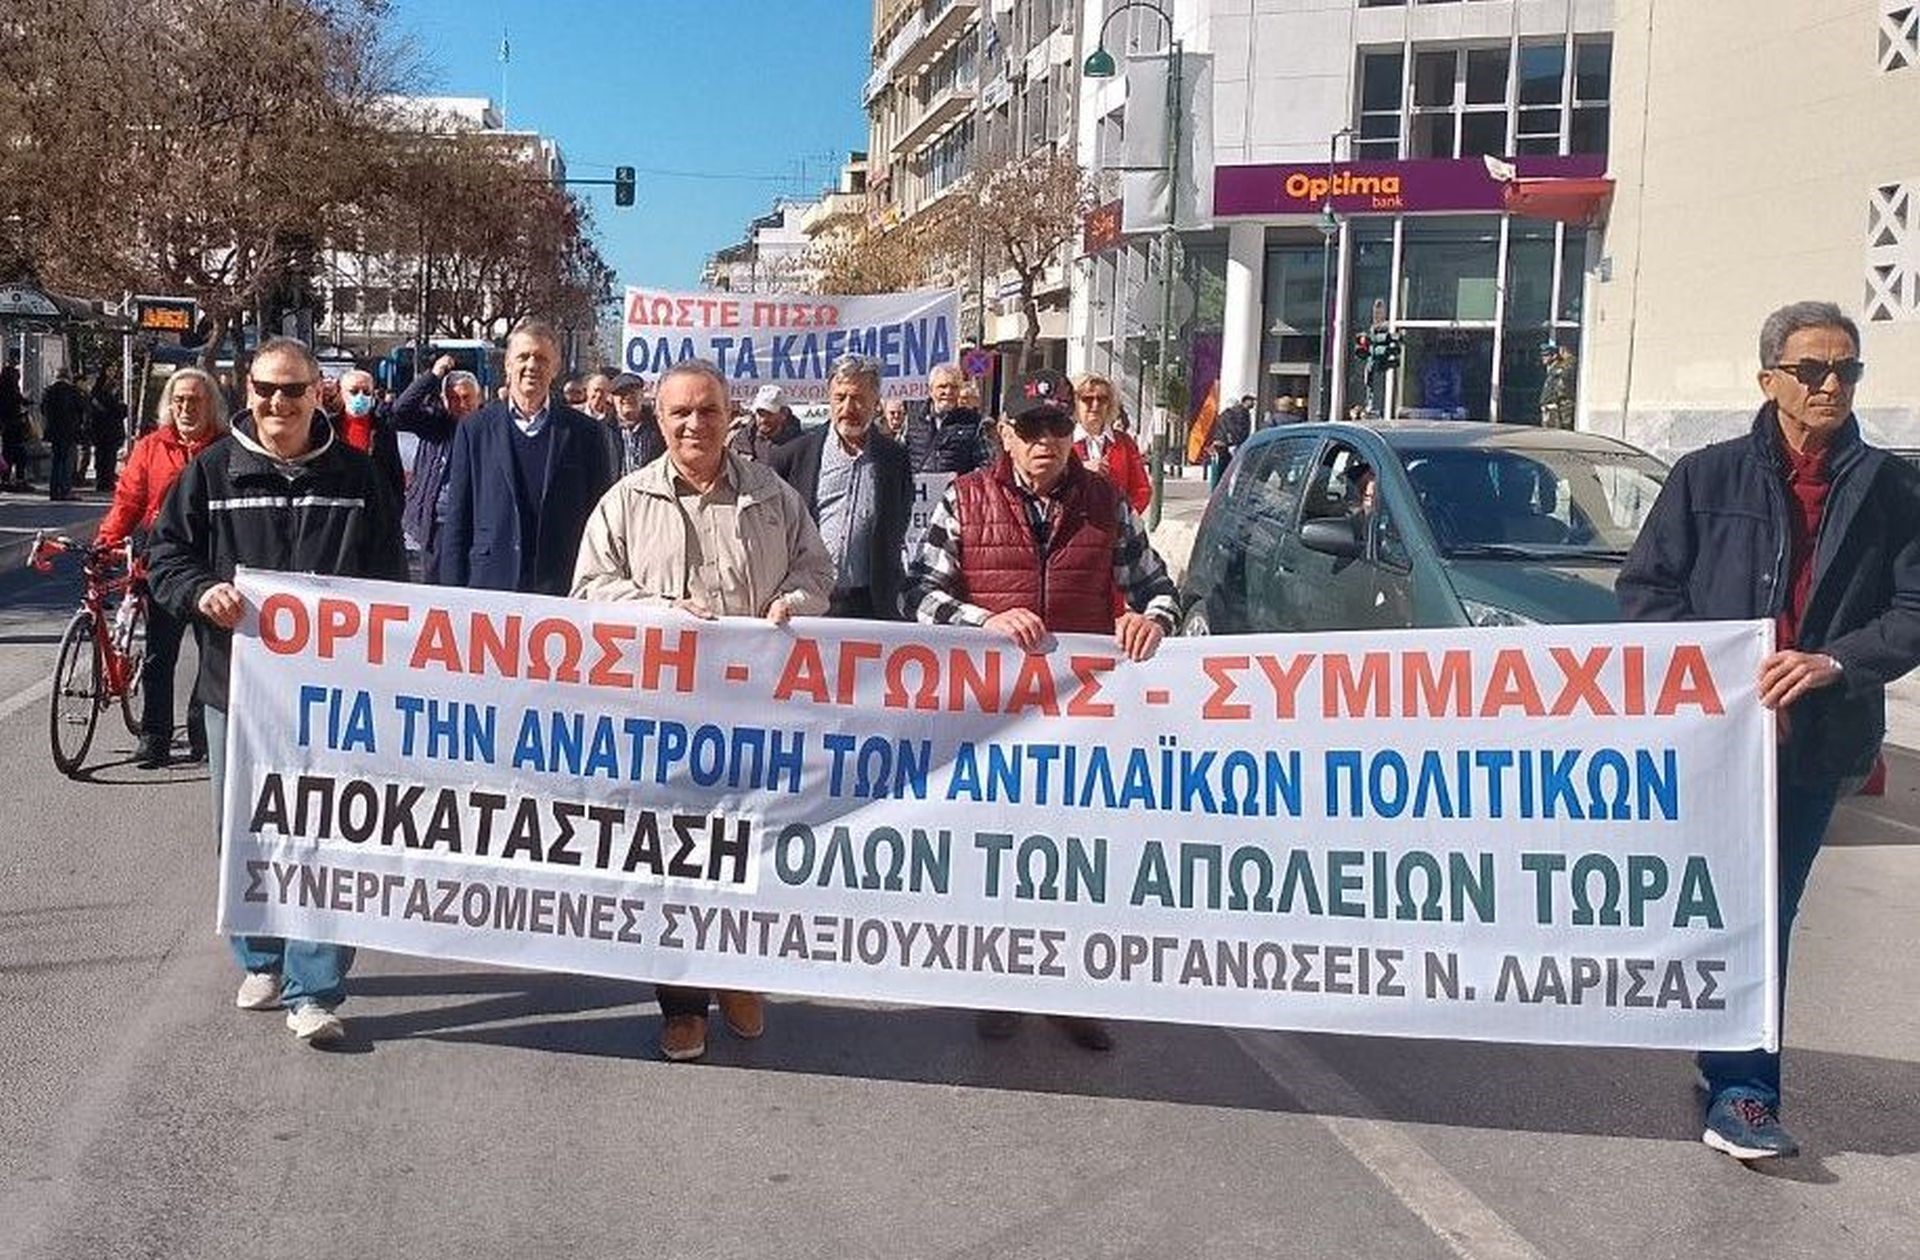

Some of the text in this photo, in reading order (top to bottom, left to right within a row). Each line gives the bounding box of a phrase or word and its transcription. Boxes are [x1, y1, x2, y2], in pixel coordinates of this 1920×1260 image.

[1286, 171, 1400, 201] Optima
[1372, 196, 1404, 208] bank
[627, 293, 838, 328] ΔΩΣΤΕ ΠΙΣΩ
[711, 336, 759, 379] ΤΑ
[258, 593, 699, 693] ΟΡΓΑΝΩΣΗ
[773, 638, 1116, 718] ΑΓΩΝΑΣ
[1201, 645, 1726, 720] ΣΥΜΜΑΧΙΑ
[298, 685, 1679, 820] ΓΙΑ ΤΗΝ ΑΝΑΤΡΟΠΗ ΤΩΝ ΑΝΤΙΛΑΪΚΩΝ ΠΟΛΙΤΙΚΩΝ
[249, 773, 1725, 929] ΑΠΟΚΑΤΑΣΤΑΣΗ ΟΛΩΝ ΤΩΝ ΑΠΩΛΕΙΩΝ ΤΩΡΑ
[244, 860, 1727, 1011] ΣΥΝΕΡΓΑΖΟΜΕΝΕΣ ΣΥΝΤΑΞΙΟΥΧΙΚΕΣ ΟΡΓΑΝΩΣΕΙΣ Ν. ΛΑΡΙΣΑΣ
